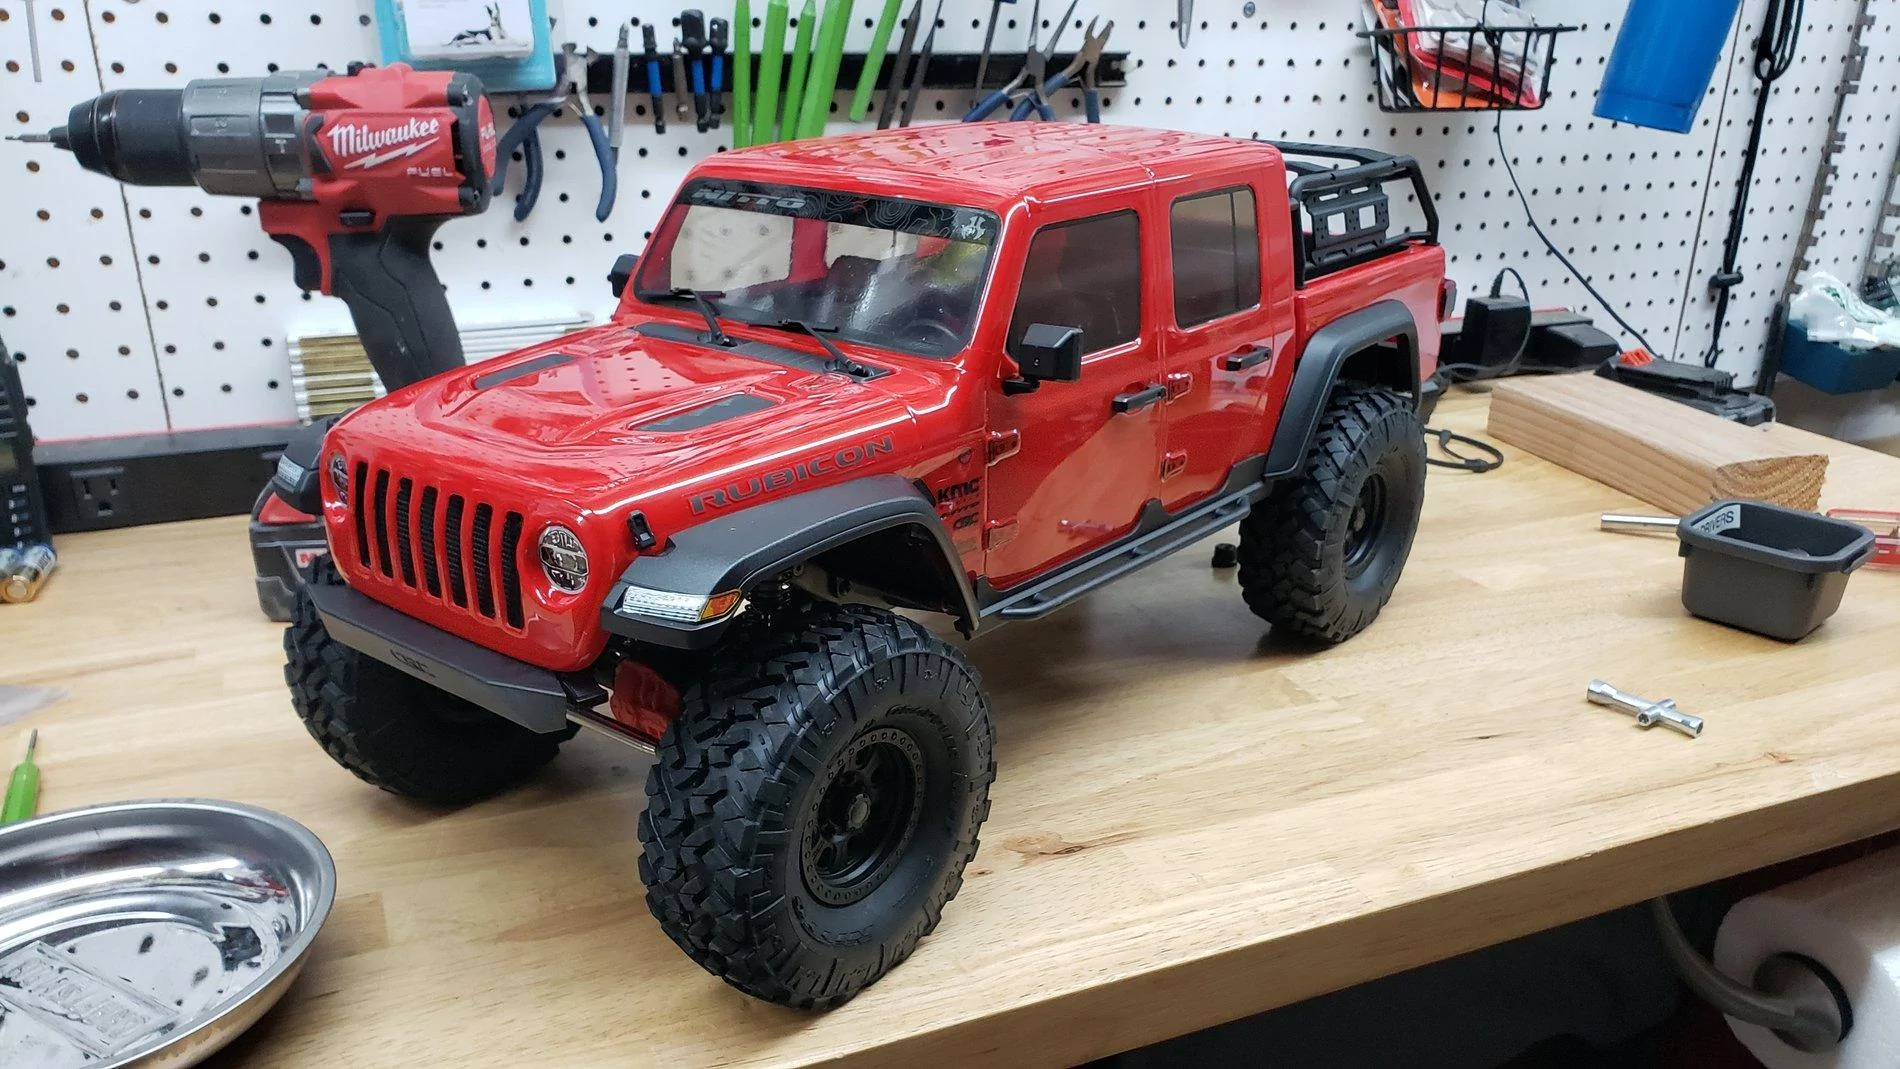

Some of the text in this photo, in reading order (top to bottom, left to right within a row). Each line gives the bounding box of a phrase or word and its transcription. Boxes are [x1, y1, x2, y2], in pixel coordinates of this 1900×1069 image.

[327, 117, 440, 157] Milwaukee
[407, 166, 453, 177] FUEL
[691, 188, 806, 208] NITTO
[688, 434, 894, 514] RUBICON
[937, 478, 982, 503] KMC
